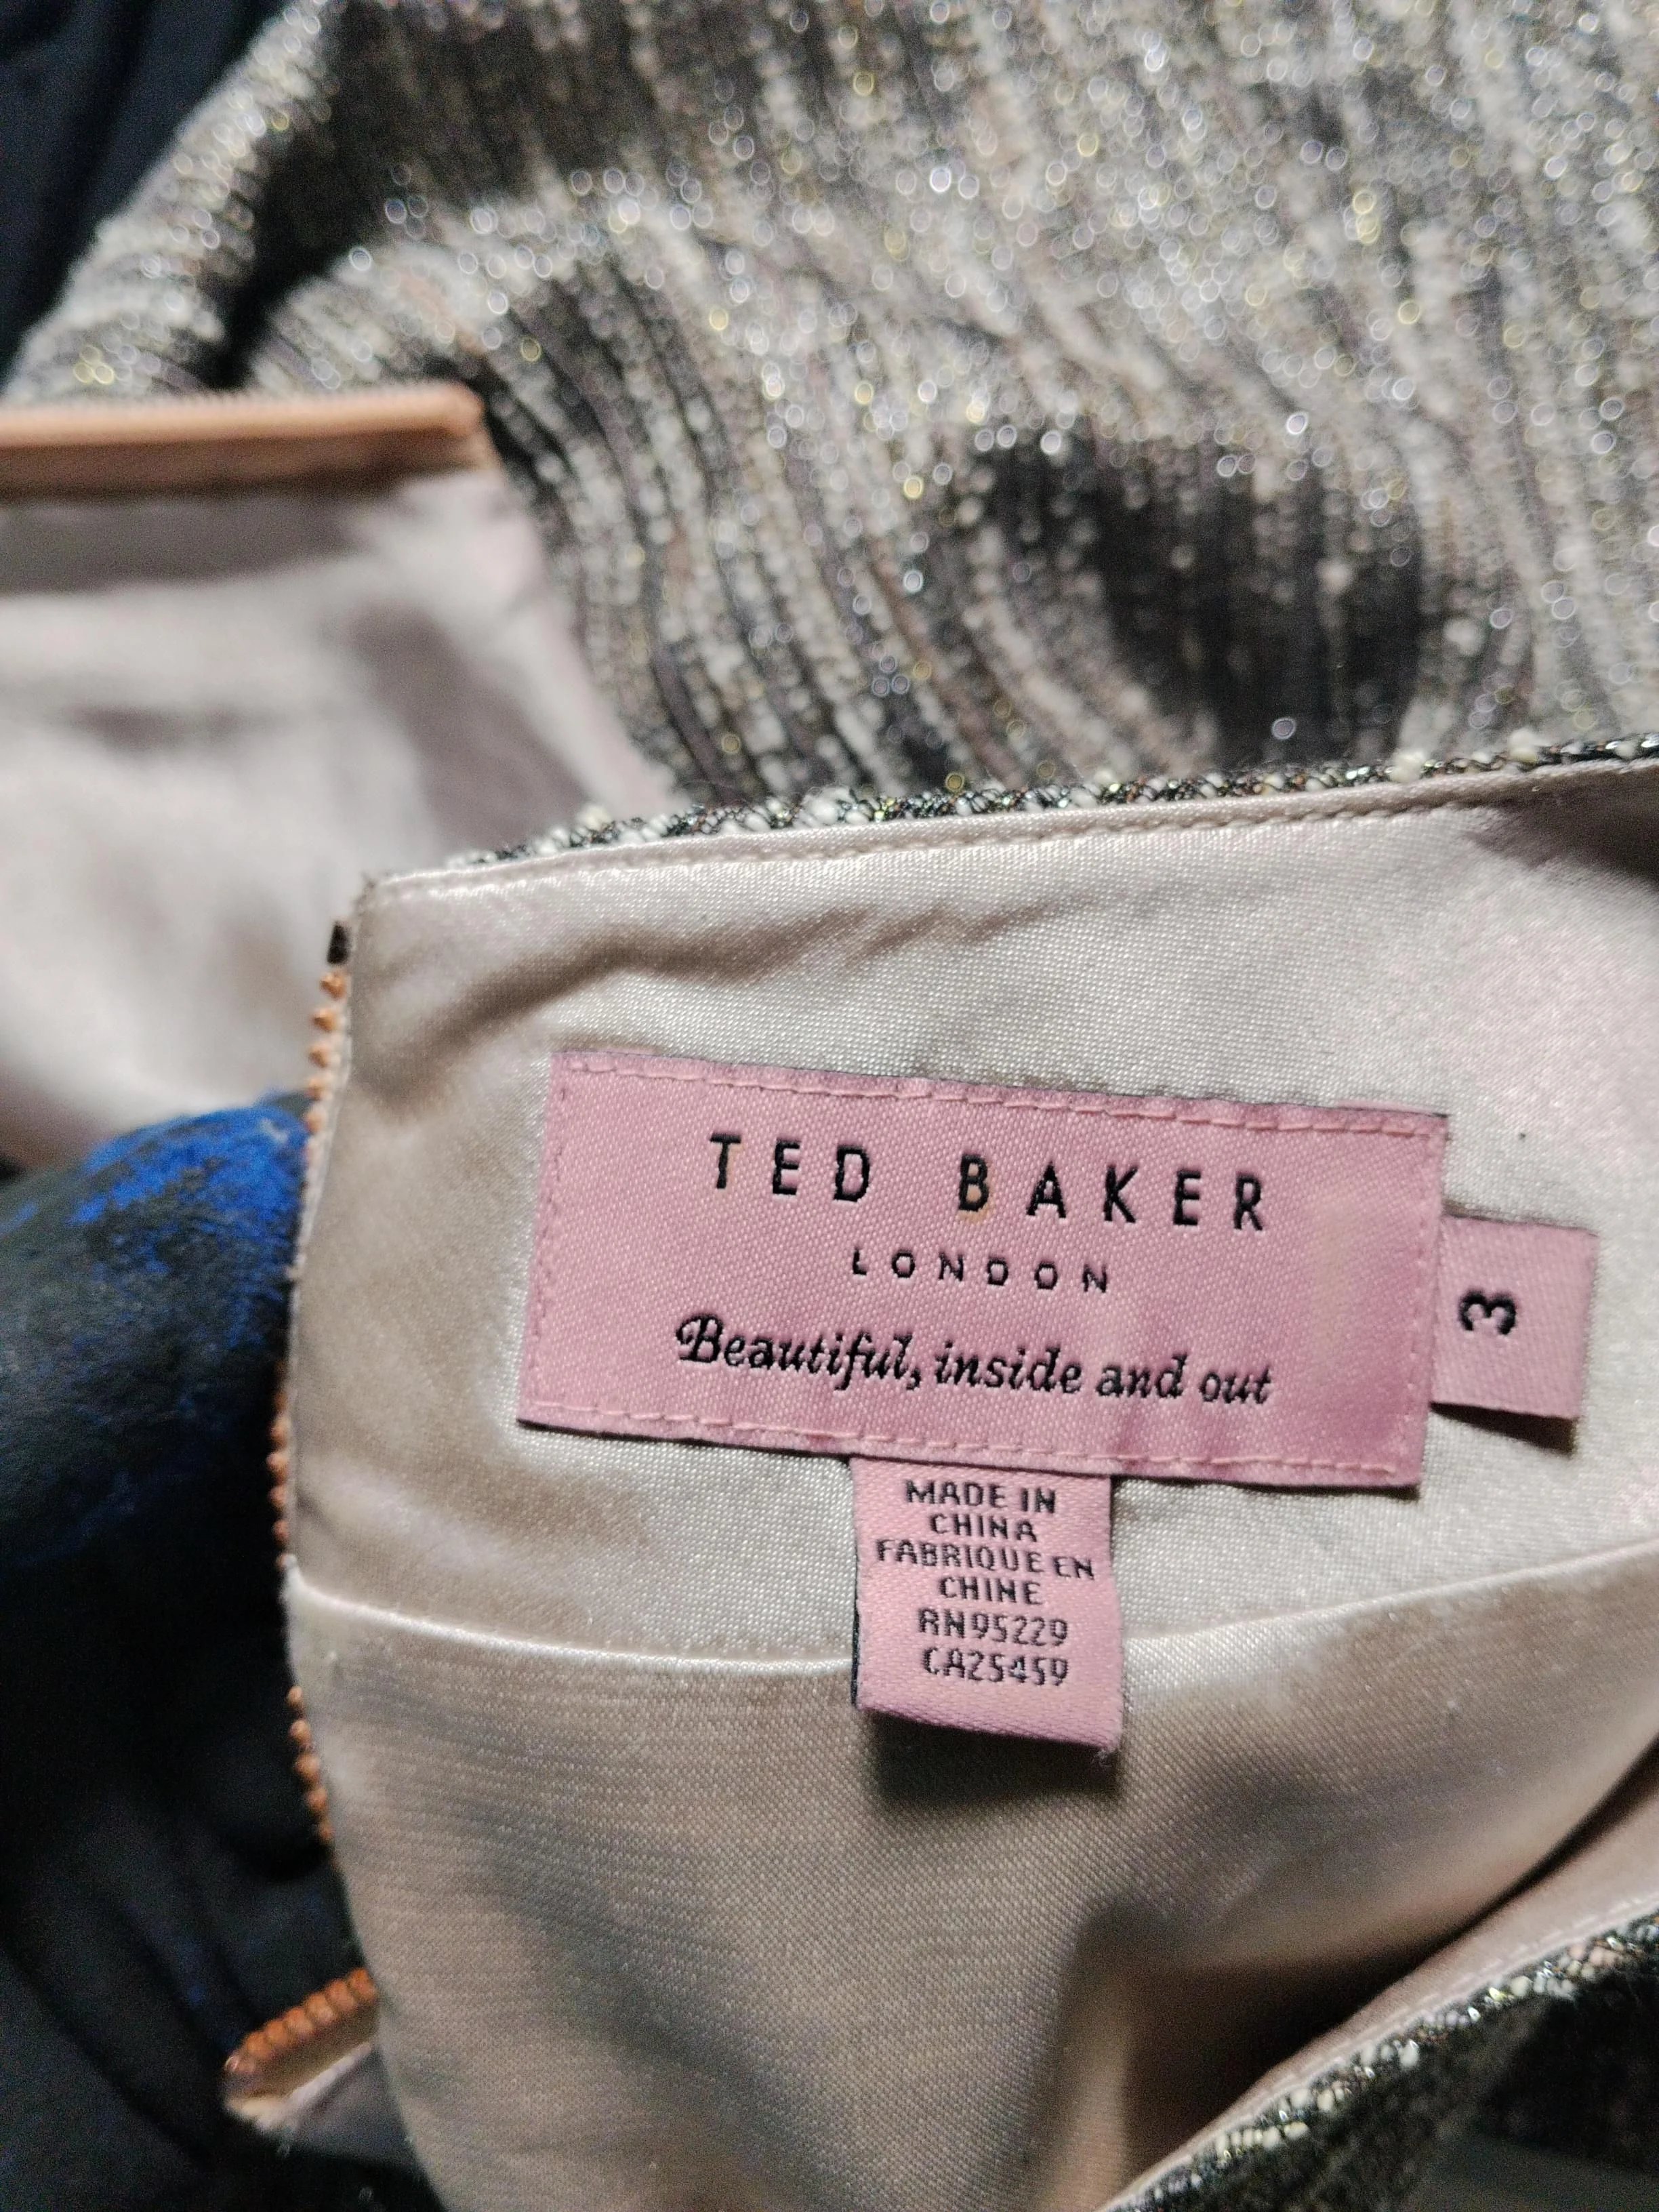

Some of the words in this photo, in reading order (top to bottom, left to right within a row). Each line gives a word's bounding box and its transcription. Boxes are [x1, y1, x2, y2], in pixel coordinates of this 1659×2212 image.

[710, 1133, 872, 1202] TED
[958, 1153, 1265, 1231] BAKER
[851, 1248, 1109, 1294] LONDON
[1460, 1290, 1517, 1335] 3
[676, 1313, 923, 1391] Beautiful,
[934, 1340, 1082, 1397] inside
[1098, 1354, 1189, 1401] and
[1198, 1366, 1273, 1407] out
[905, 1479, 1008, 1509] MADE
[1020, 1487, 1057, 1513] IN
[929, 1513, 1038, 1543] CHINA
[876, 1539, 1044, 1574] FABRIQUE
[1053, 1555, 1095, 1580] EN
[939, 1576, 1042, 1605] CHINE
[918, 1607, 1069, 1647] RN95229
[922, 1647, 1069, 1687] CA25459
